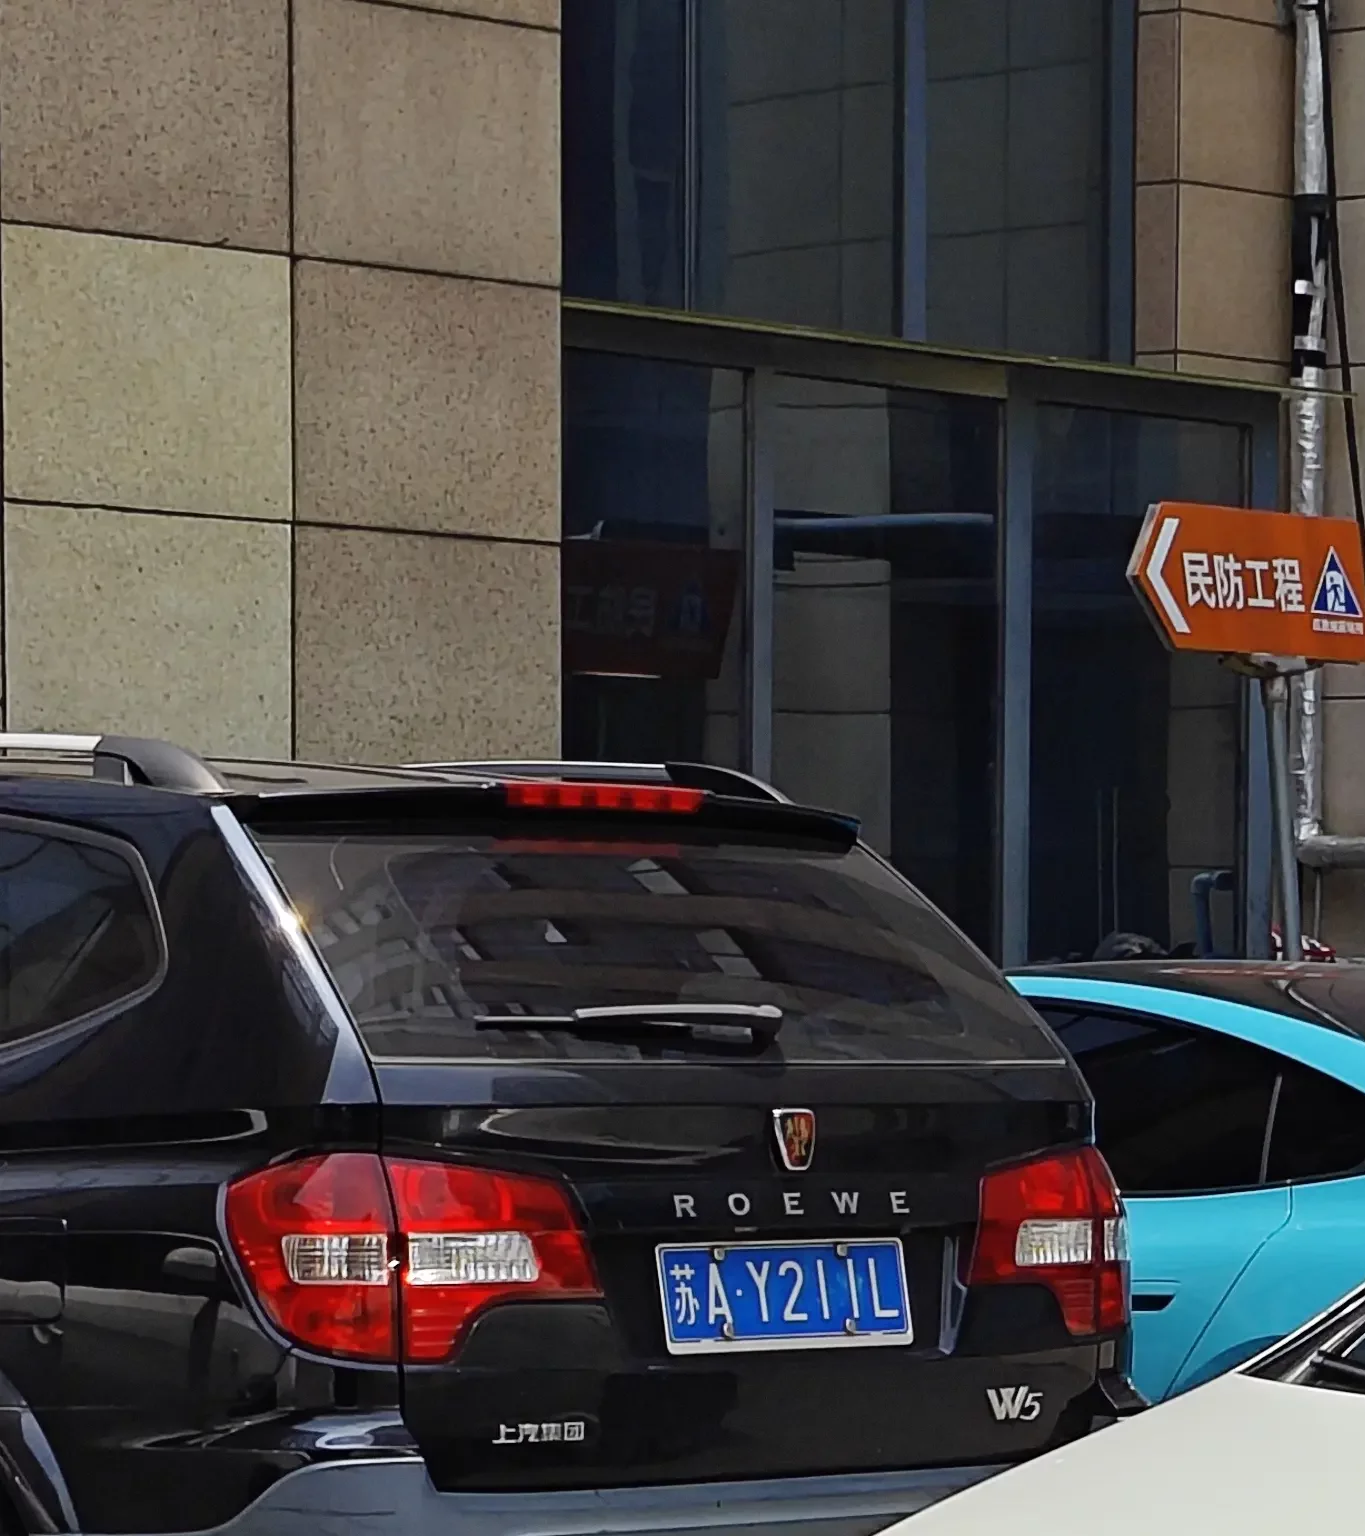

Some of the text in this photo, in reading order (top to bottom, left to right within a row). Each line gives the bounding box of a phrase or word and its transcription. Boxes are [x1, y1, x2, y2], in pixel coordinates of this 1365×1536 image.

[1182, 551, 1306, 613] 民防工程
[673, 1191, 910, 1218] ROEWE
[985, 1385, 1044, 1421] W5
